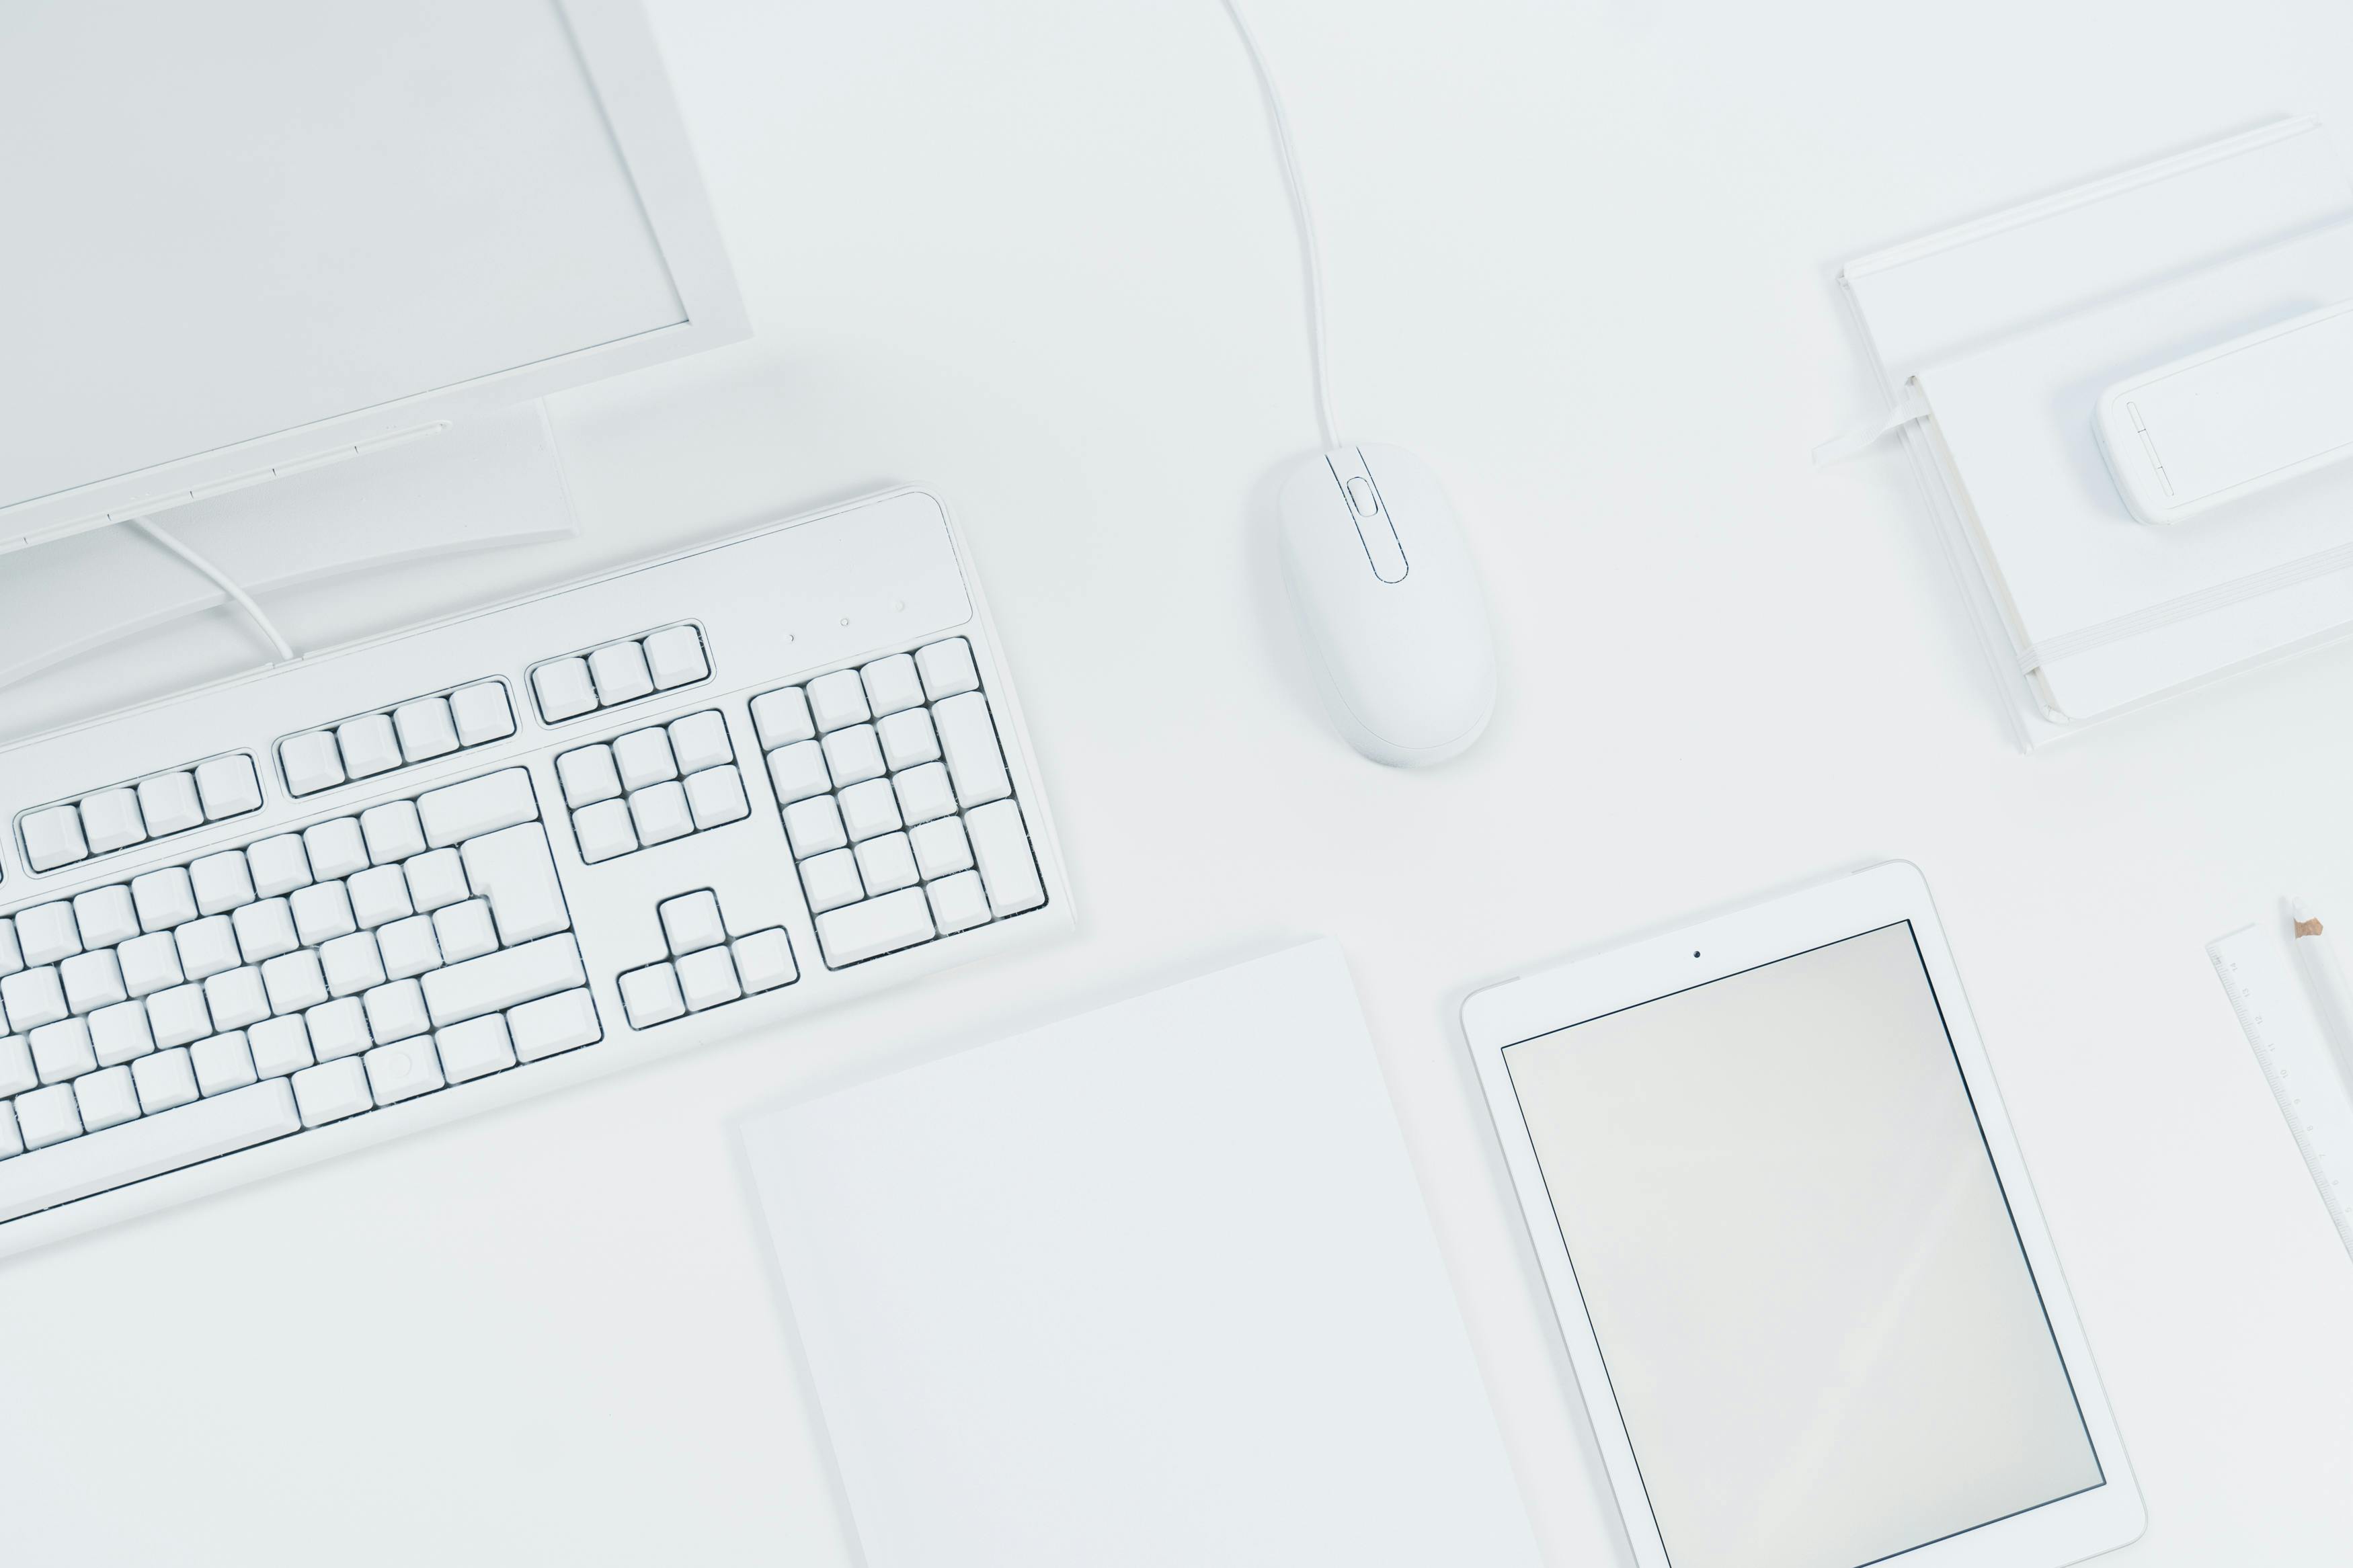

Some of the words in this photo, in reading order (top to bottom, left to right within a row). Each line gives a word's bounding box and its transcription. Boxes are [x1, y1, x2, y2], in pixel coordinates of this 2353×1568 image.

[2229, 962, 2238, 973] 14
[2242, 988, 2250, 998] 13
[2254, 1016, 2264, 1025] 12
[2267, 1043, 2276, 1053] 11
[2280, 1070, 2288, 1079] 10
[2319, 1153, 2327, 1161] 7
